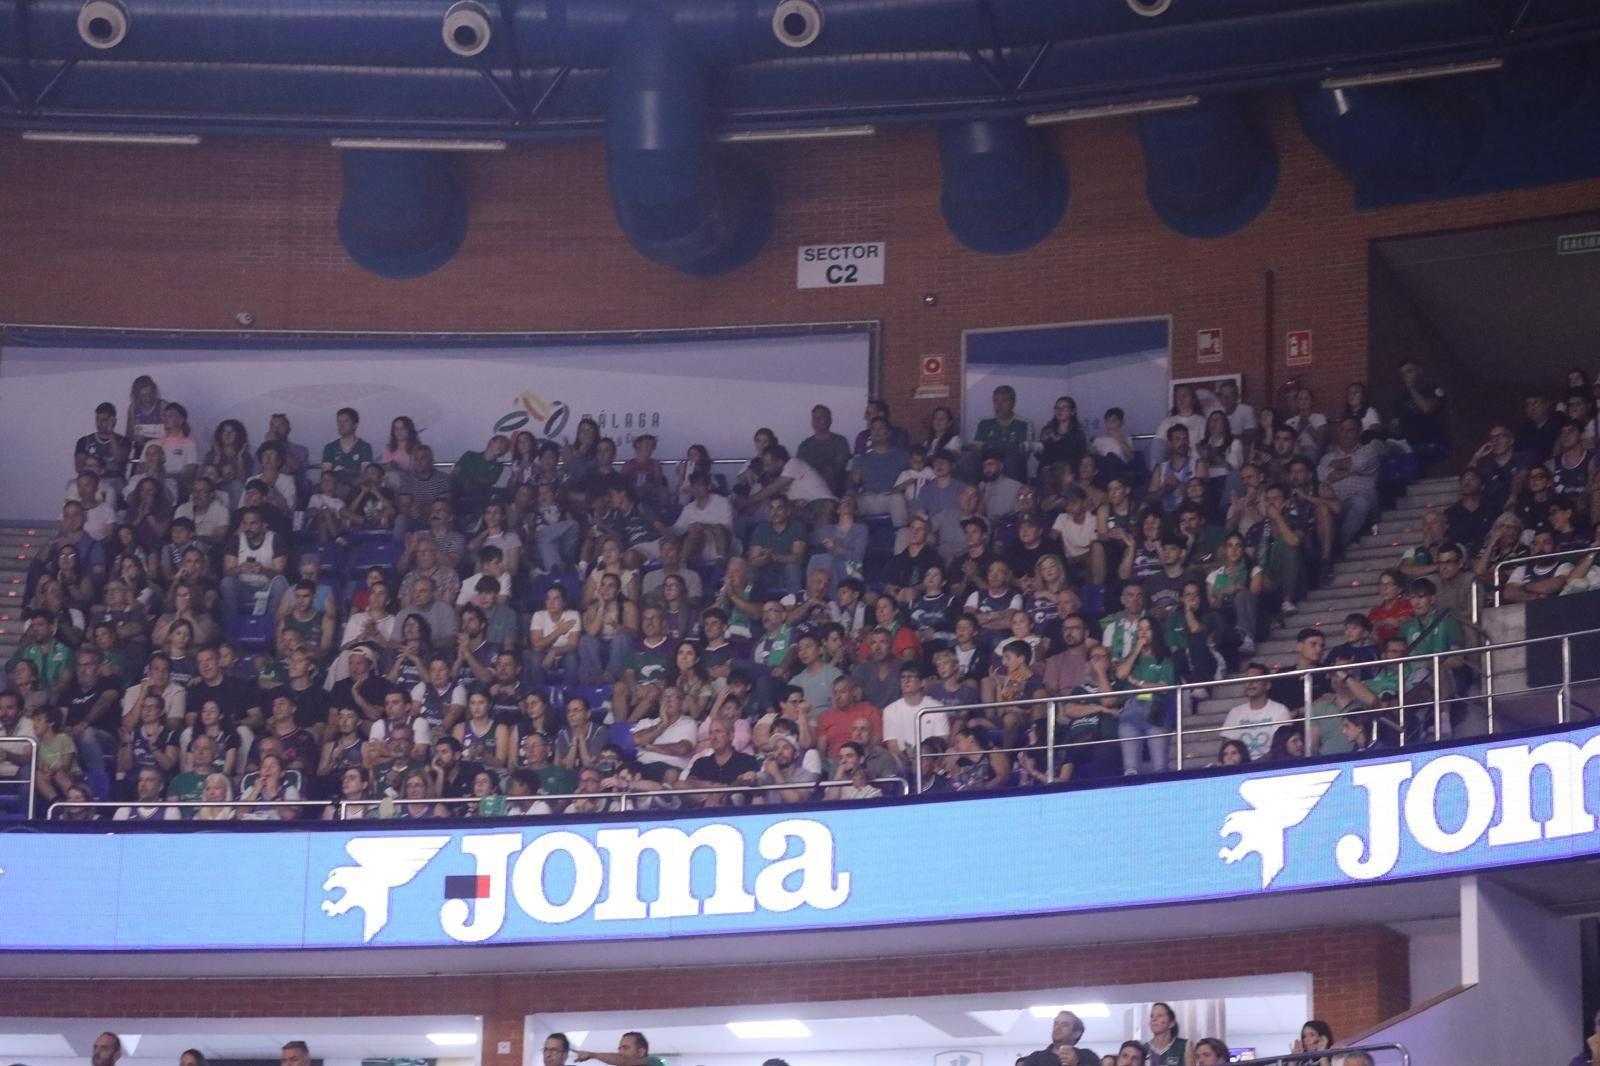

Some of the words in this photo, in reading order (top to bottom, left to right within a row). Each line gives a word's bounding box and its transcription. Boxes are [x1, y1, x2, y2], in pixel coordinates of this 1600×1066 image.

[804, 245, 879, 262] SECTOR
[826, 264, 858, 284] C2
[439, 819, 850, 942] Joma
